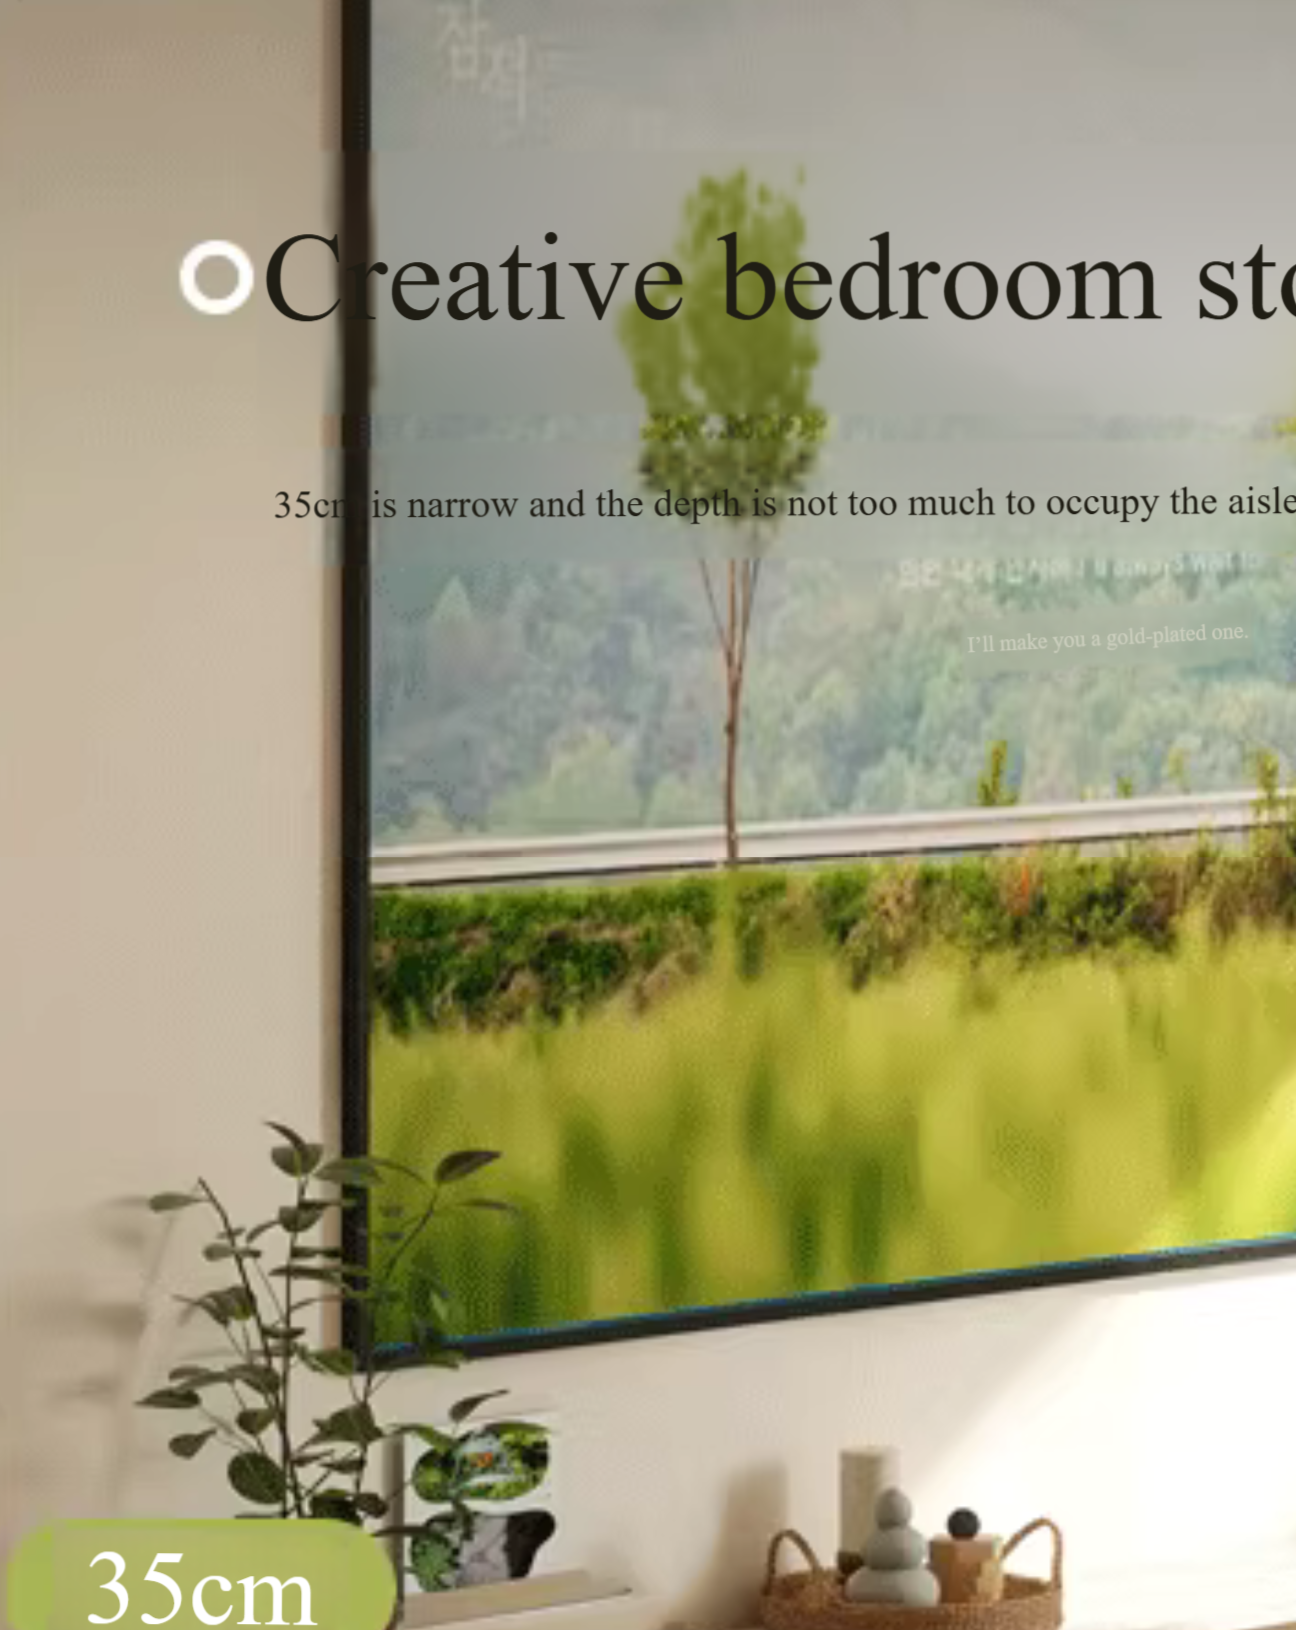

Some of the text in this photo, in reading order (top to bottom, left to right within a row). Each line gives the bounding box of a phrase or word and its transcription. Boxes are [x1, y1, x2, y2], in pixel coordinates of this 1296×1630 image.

[999, 632, 1049, 652] make
[1052, 634, 1087, 654] you
[1090, 633, 1102, 648] a
[1106, 623, 1207, 651] gold-plated
[1211, 625, 1250, 642] one.
